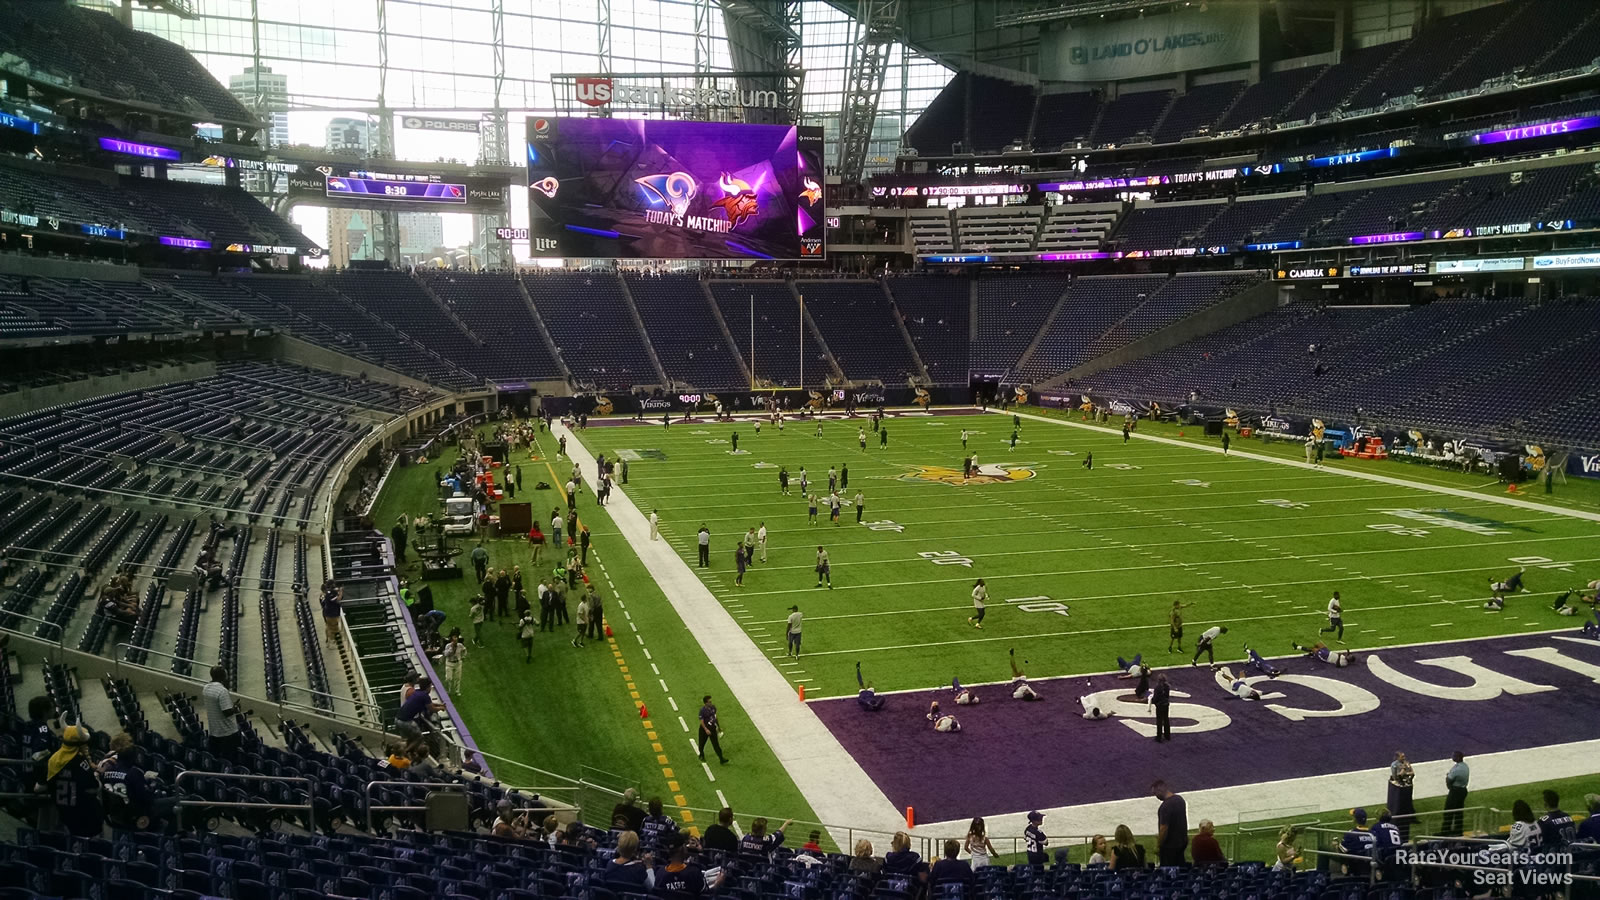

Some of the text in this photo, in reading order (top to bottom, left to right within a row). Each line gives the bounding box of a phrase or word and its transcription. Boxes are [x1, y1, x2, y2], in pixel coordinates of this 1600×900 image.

[1092, 42, 1132, 60] LAND
[424, 120, 477, 131] POLARIS
[1505, 122, 1569, 140] VIKINGS
[117, 143, 159, 157] VIKINGS
[1329, 154, 1361, 166] RAMS
[238, 159, 298, 173] TODAY'S MATCHUP
[1175, 169, 1237, 183] TODAY'S MATCHUP
[385, 186, 407, 195] 8:30
[0, 210, 39, 227] TODAY'S MATCHUP
[645, 209, 733, 234] TODAY'S MATCHUP
[827, 218, 839, 227] 40
[89, 226, 107, 237] RAMS
[497, 228, 528, 239] 90:00
[1475, 223, 1531, 236] TODAY'S MATCHUP
[170, 237, 197, 248] VIKINGS
[1367, 233, 1406, 243] VIKINGS
[535, 237, 557, 251] Lite
[1256, 243, 1279, 251] RAMS
[252, 245, 297, 255] TODAY'S MATCHUP
[1153, 247, 1196, 257] TODAY'S MATCHUP
[1289, 269, 1324, 278] CAMBRIA
[679, 394, 701, 403] 90:00
[917, 550, 974, 567] 20
[1005, 595, 1069, 613] 10
